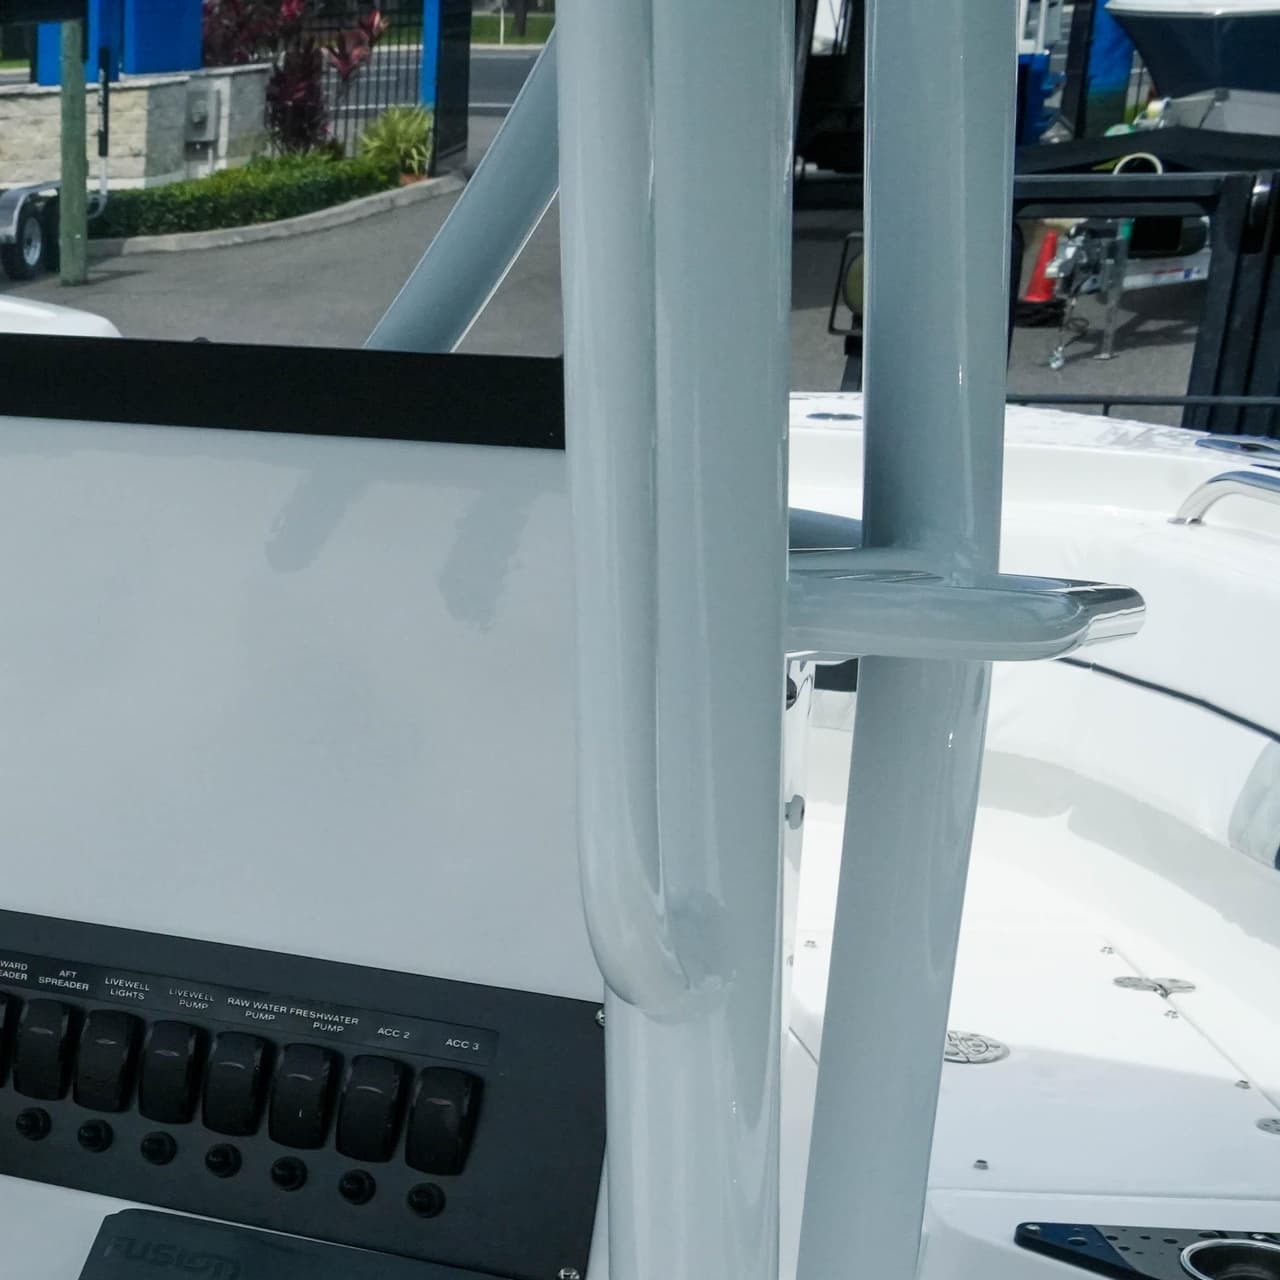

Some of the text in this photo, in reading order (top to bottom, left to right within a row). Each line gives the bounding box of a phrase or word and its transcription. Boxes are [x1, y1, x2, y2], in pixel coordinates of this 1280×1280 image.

[59, 969, 78, 979] AFT
[38, 976, 90, 991] SPREADER
[104, 977, 151, 991] LIVEWELL
[110, 988, 145, 1000] LIGHTS
[169, 988, 215, 1002] LIVEWELL
[179, 999, 209, 1010] PUMP
[227, 997, 288, 1014] RAW WATER
[245, 1010, 276, 1021] PUMP
[289, 1007, 360, 1025] FRESHWATER
[312, 1021, 344, 1033] PUMP
[377, 1027, 410, 1039] ACC 2
[445, 1038, 480, 1051] ACC 3
